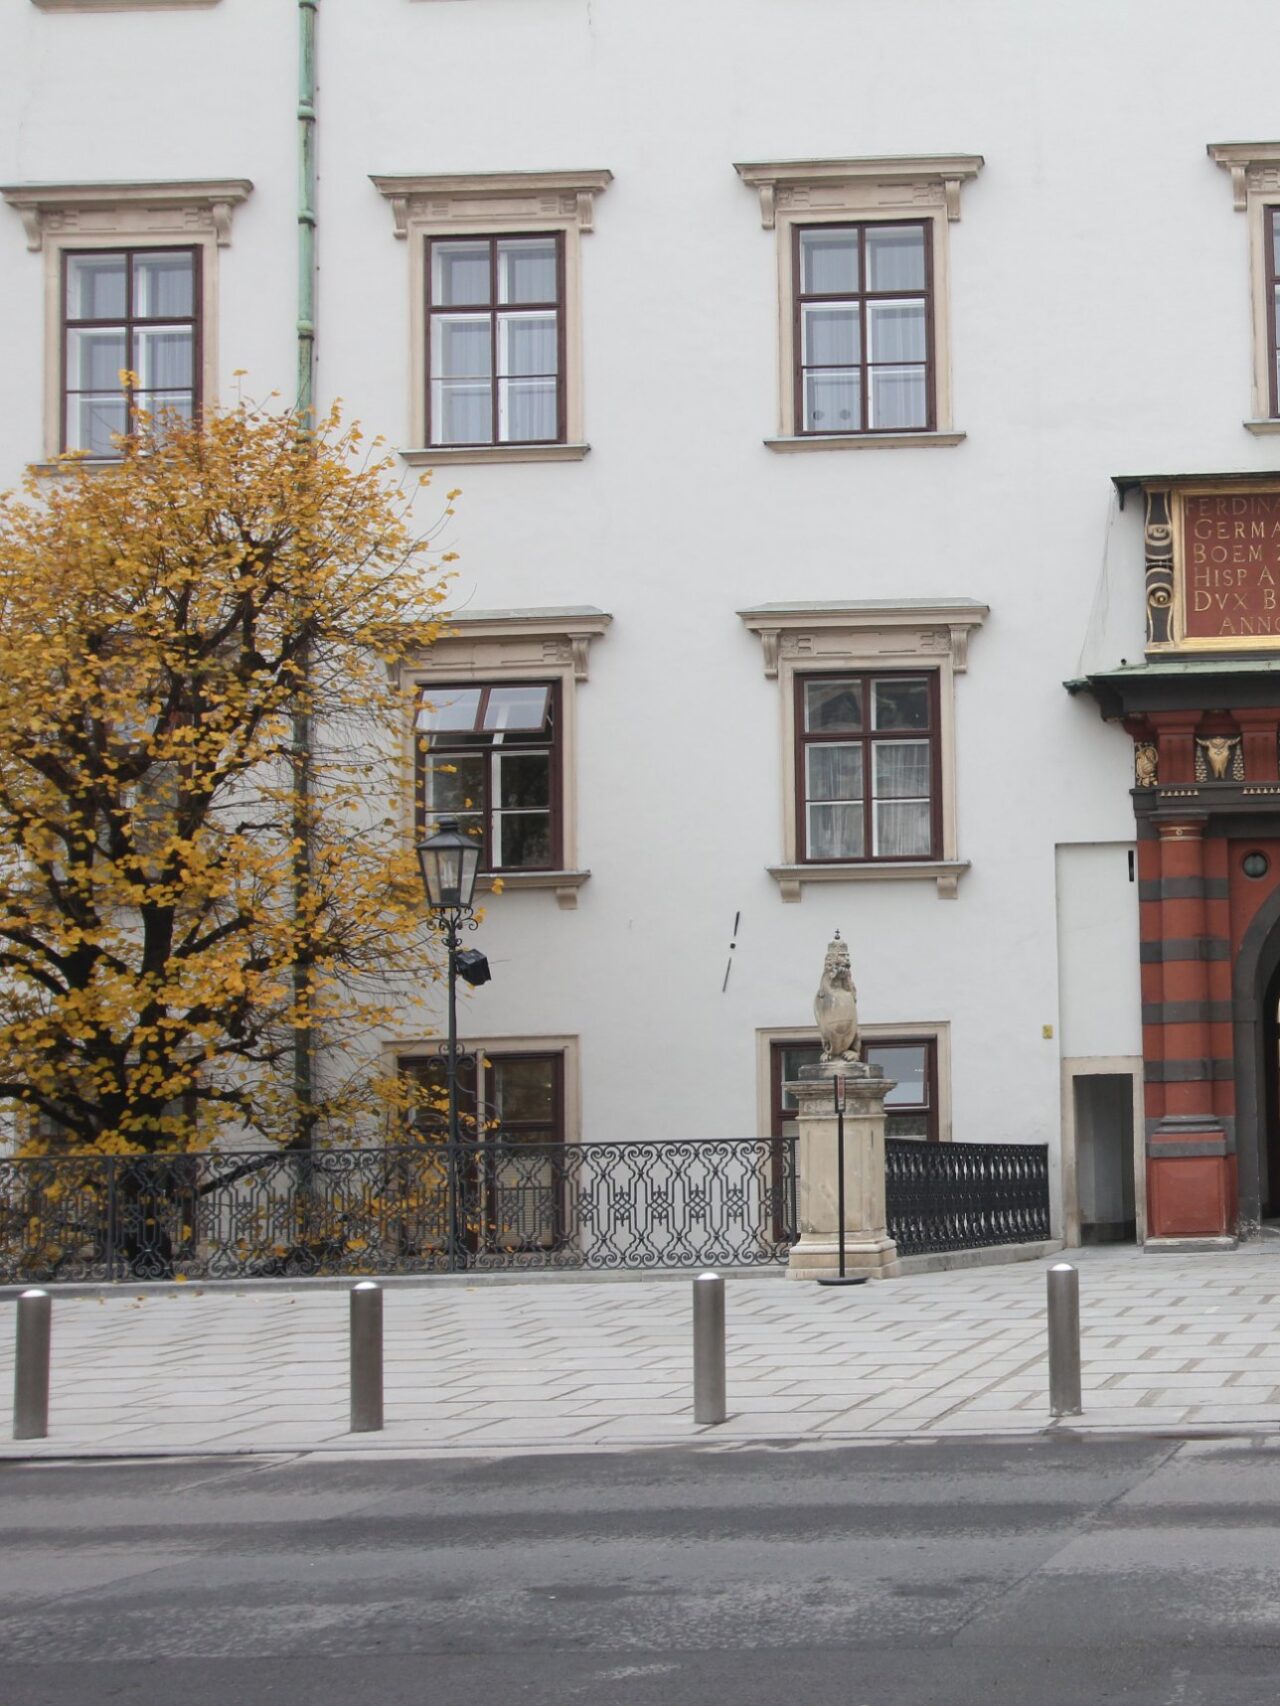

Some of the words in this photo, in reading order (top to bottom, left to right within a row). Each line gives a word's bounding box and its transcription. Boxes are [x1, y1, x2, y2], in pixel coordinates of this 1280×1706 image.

[1194, 543, 1262, 563] BOEM
[1194, 567, 1247, 587] HISP
[1194, 591, 1248, 611] DVX
